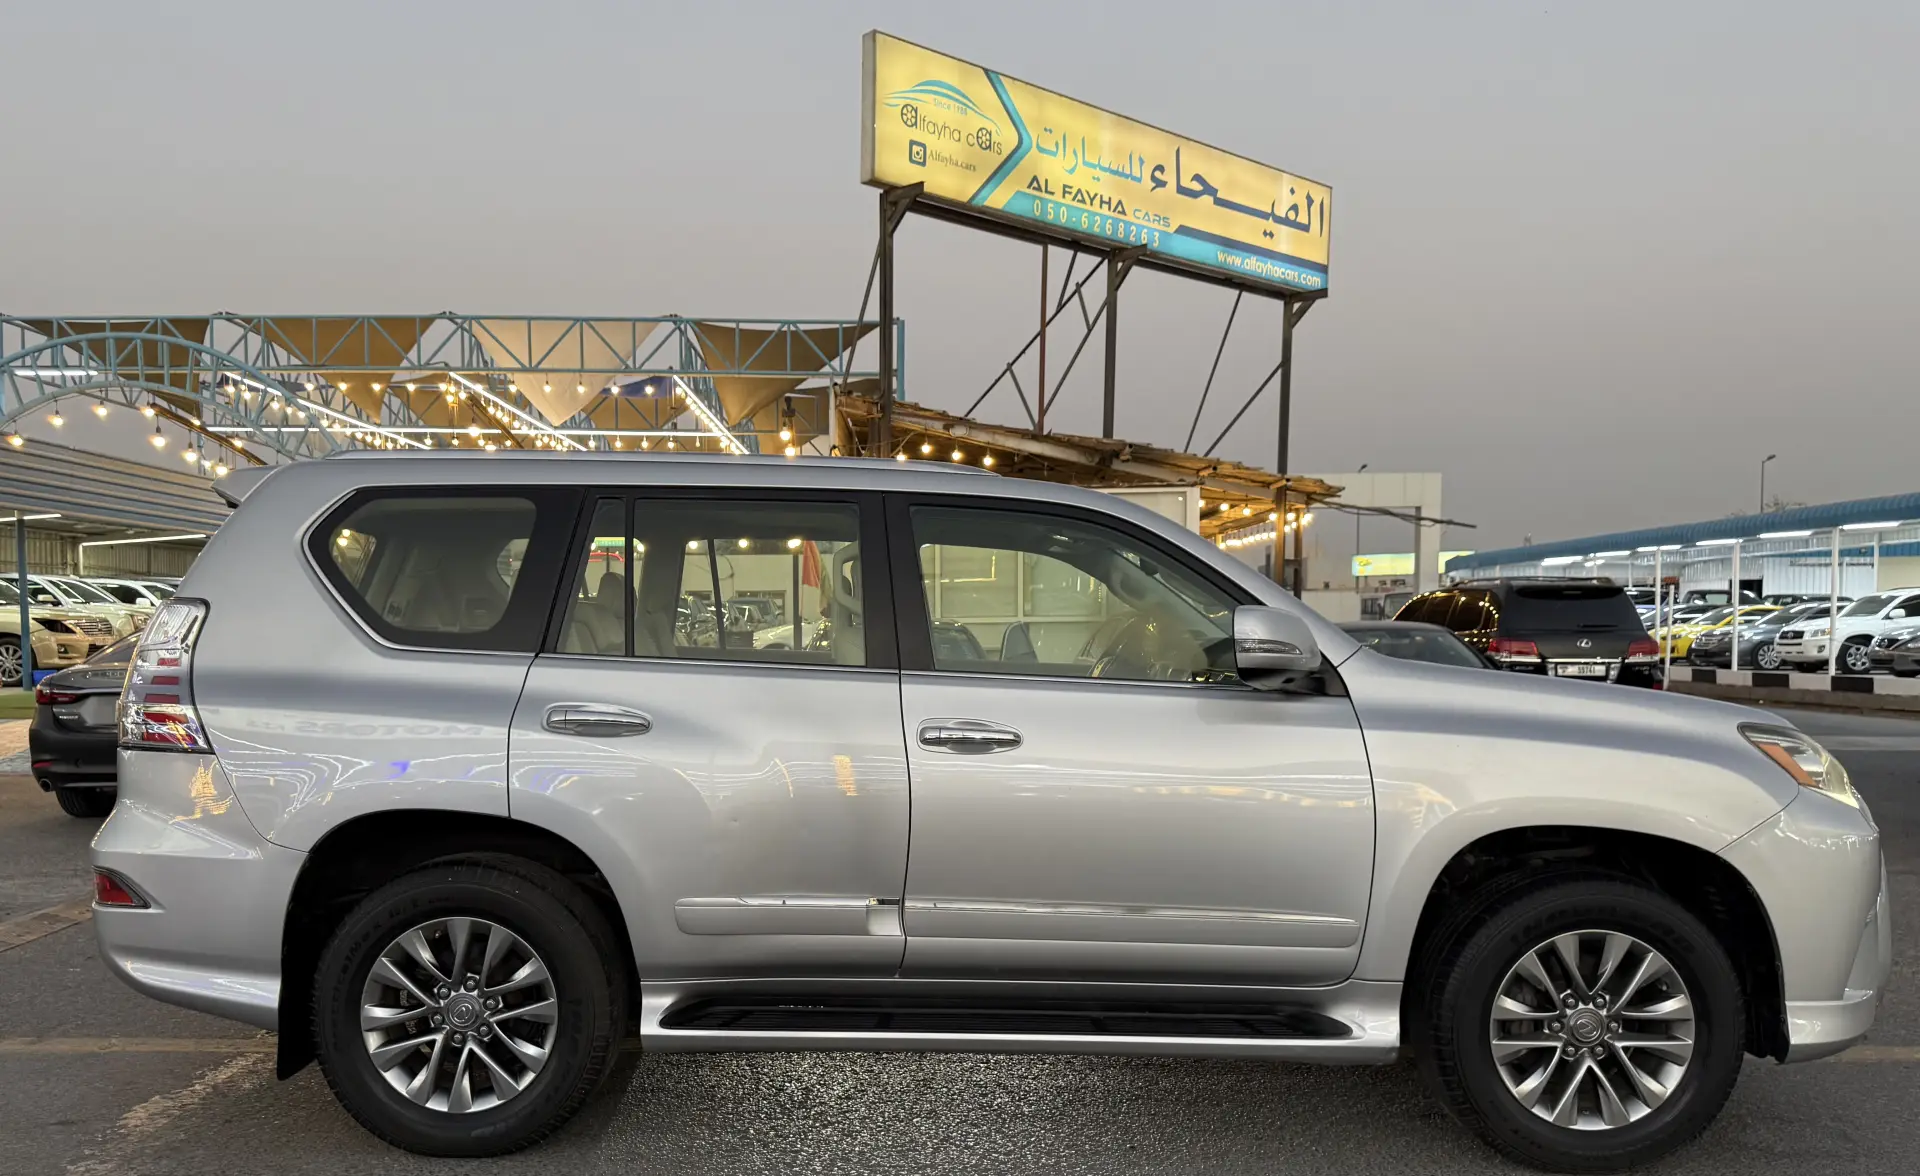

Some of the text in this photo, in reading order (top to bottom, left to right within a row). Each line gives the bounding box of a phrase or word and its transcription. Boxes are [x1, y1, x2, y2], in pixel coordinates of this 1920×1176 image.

[966, 127, 1002, 155] cars
[1026, 175, 1171, 228] AL FAYHA CARS
[1035, 127, 1325, 239] الفيحاء للسيارات
[1217, 250, 1321, 287] www.alfayhacars.com
